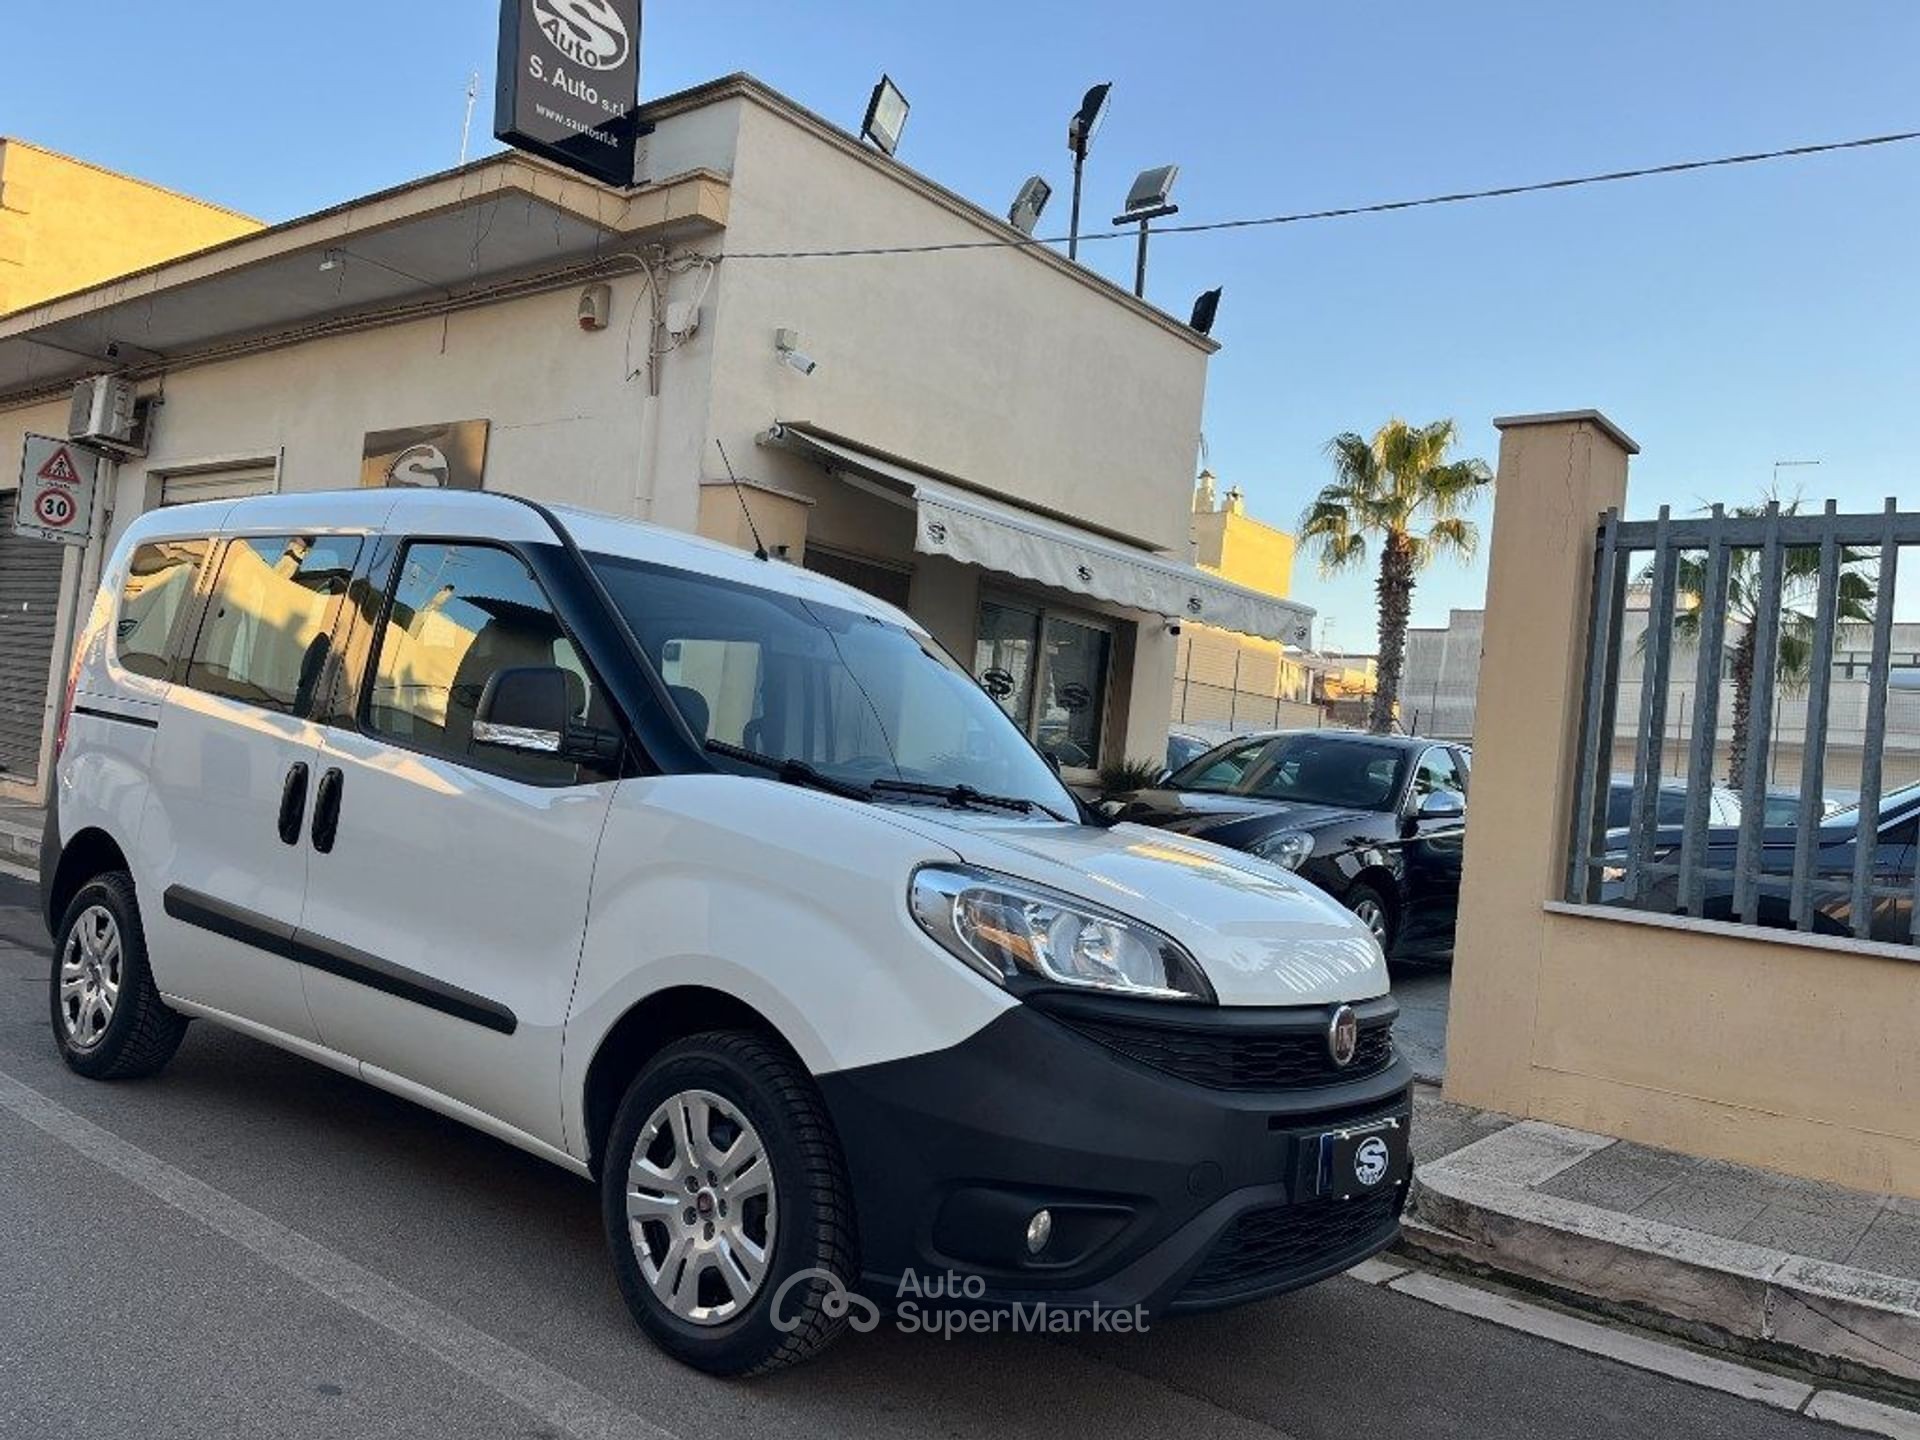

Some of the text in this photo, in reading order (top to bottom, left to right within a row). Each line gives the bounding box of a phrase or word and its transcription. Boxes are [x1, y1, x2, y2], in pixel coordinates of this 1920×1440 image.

[542, 19, 598, 67] Auto
[529, 54, 548, 82] S.
[552, 67, 598, 105] Auto
[44, 498, 67, 518] 30
